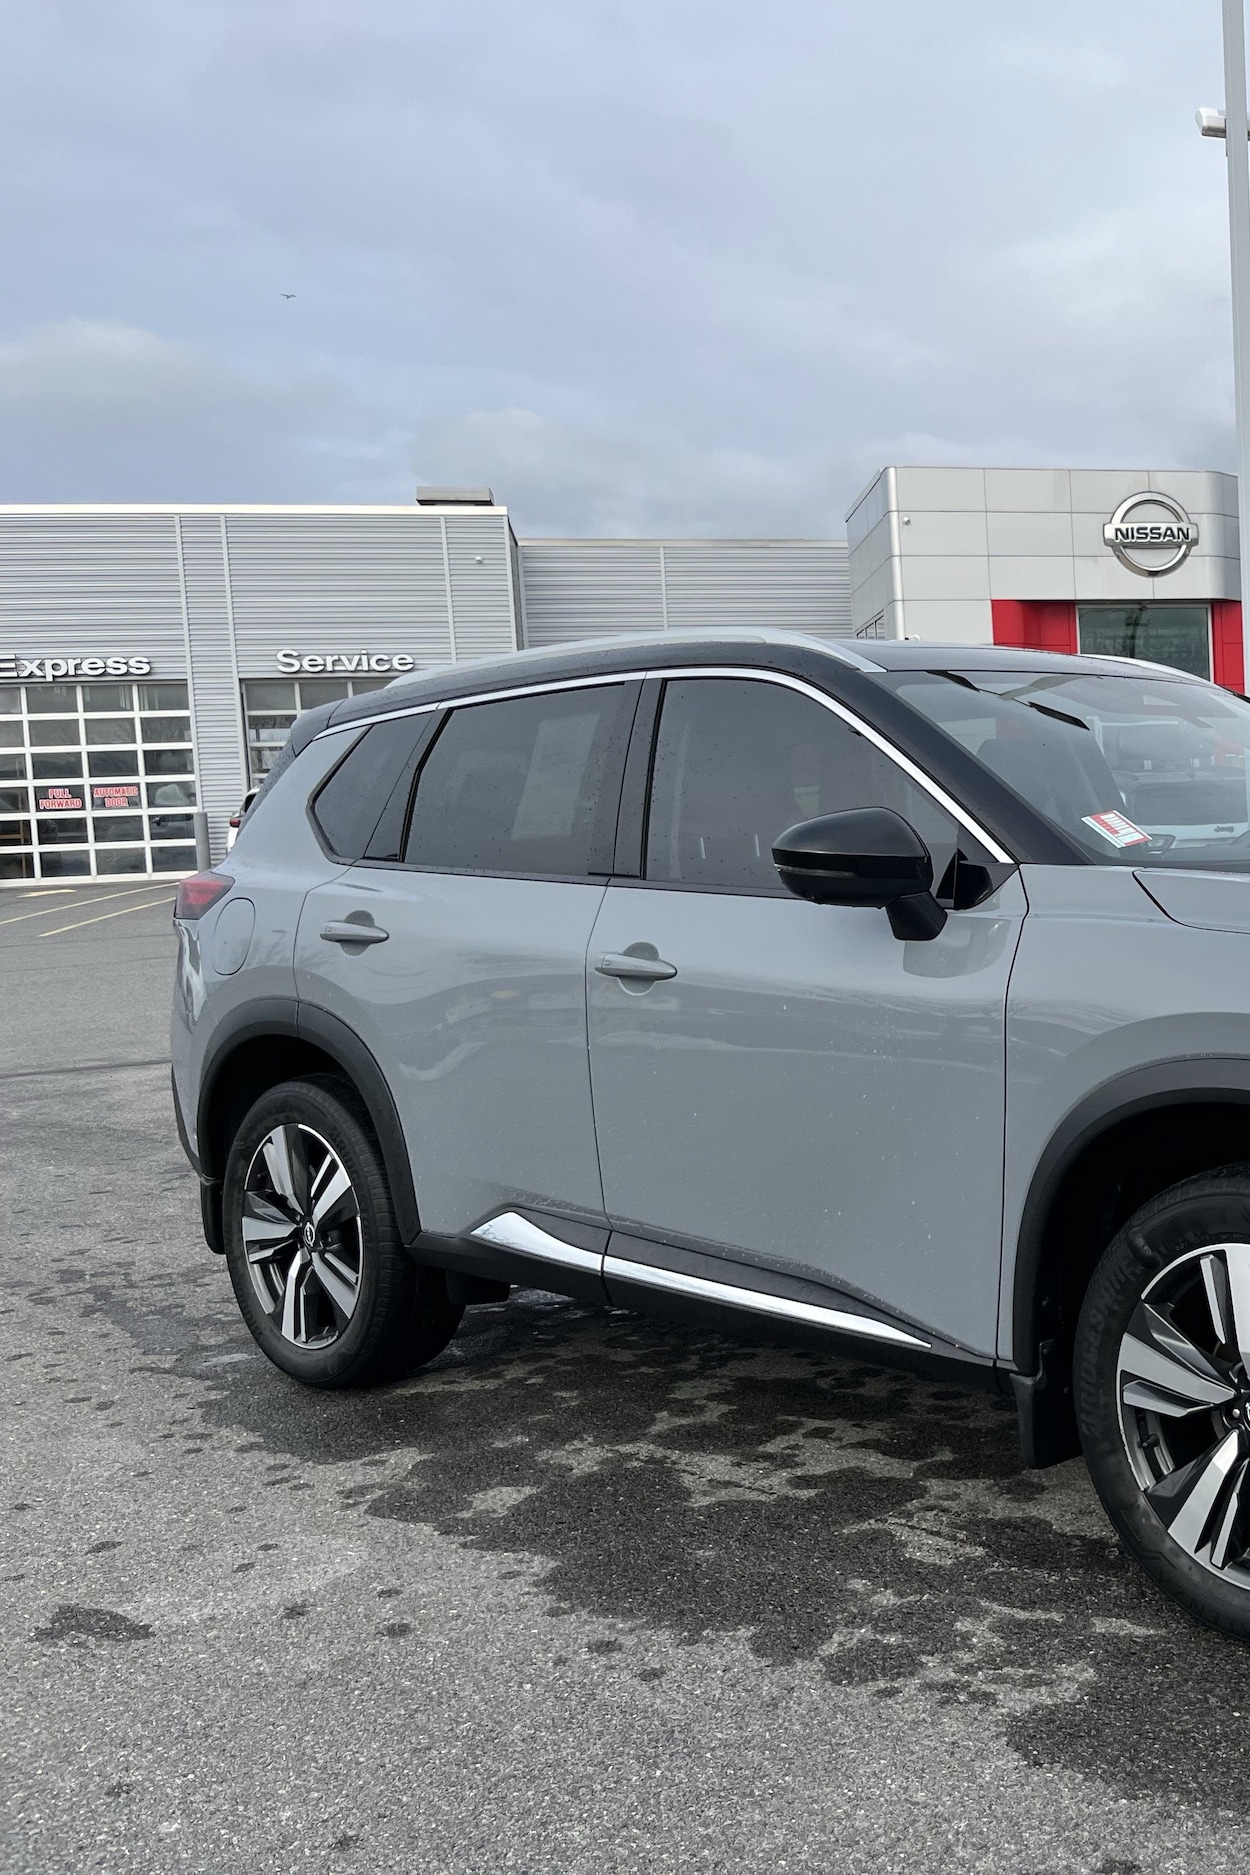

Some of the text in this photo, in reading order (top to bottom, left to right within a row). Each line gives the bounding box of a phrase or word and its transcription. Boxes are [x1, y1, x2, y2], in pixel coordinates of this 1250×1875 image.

[1114, 526, 1190, 542] NISSAN
[276, 649, 415, 673] Service
[0, 654, 151, 681] Express
[48, 788, 72, 799] PULL
[93, 786, 139, 798] AUTOMATIC
[39, 798, 82, 810] FORWARD
[104, 797, 129, 808] DOOR
